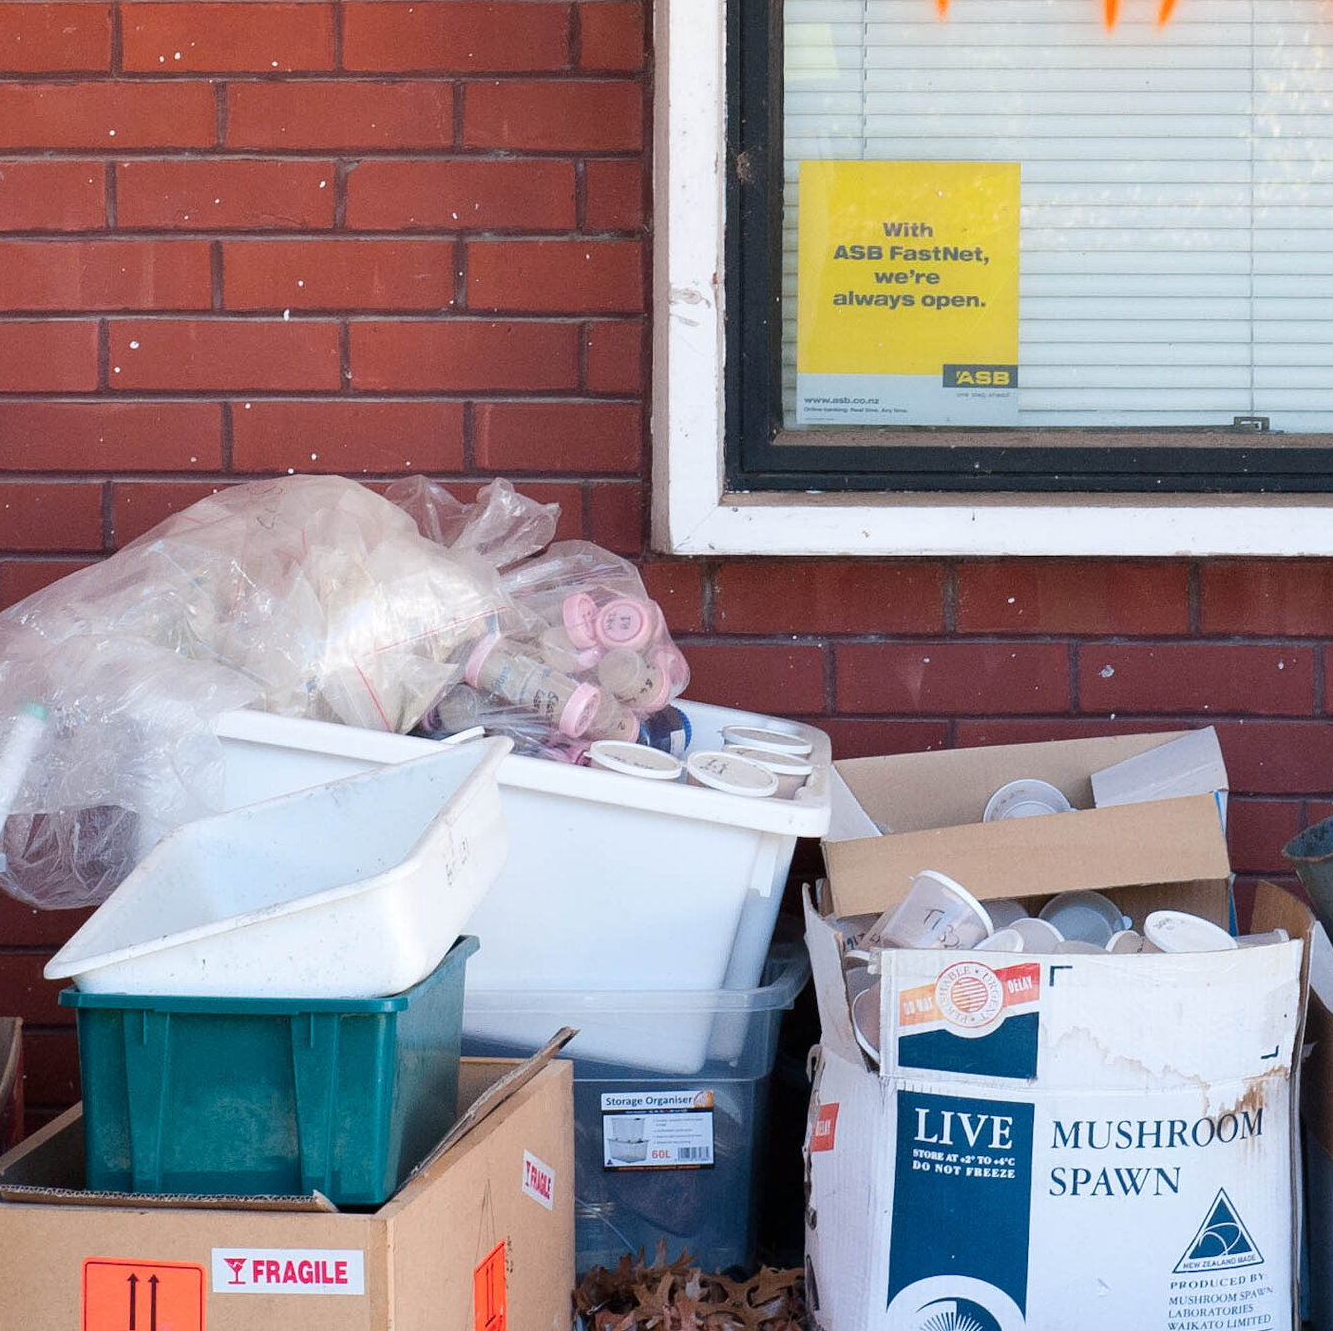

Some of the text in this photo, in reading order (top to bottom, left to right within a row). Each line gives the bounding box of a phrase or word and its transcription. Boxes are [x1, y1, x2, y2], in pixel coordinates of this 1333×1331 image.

[882, 222, 934, 238] With
[833, 245, 990, 266] ASB FastNet,
[874, 269, 941, 285] we're
[832, 291, 987, 310] always open.
[956, 370, 1011, 386] ASB
[804, 397, 880, 405] www.asb.co.nz
[606, 1095, 692, 1107] Storage Organiser
[914, 1108, 1013, 1149] LIVE
[1050, 1108, 1264, 1150] MUSHROOM
[651, 1149, 671, 1159] 60L
[912, 1149, 944, 1161] STORE
[946, 1153, 959, 1162] AT
[977, 1156, 992, 1165] TO
[912, 1160, 1016, 1179] DO NOT FREEZE
[530, 1165, 552, 1200] FRAGILE
[1049, 1166, 1181, 1197] SPAWN
[1202, 1257, 1236, 1268] ZEALAND
[1238, 1254, 1257, 1264] MADE
[252, 1260, 349, 1284] FRAGILE
[1170, 1275, 1246, 1290] PRODUCED
[1169, 1285, 1274, 1306] MUSHROOM SPAWN
[1168, 1303, 1254, 1319] LABORATORIES
[1168, 1314, 1272, 1331] WAIKATO LIMITED
